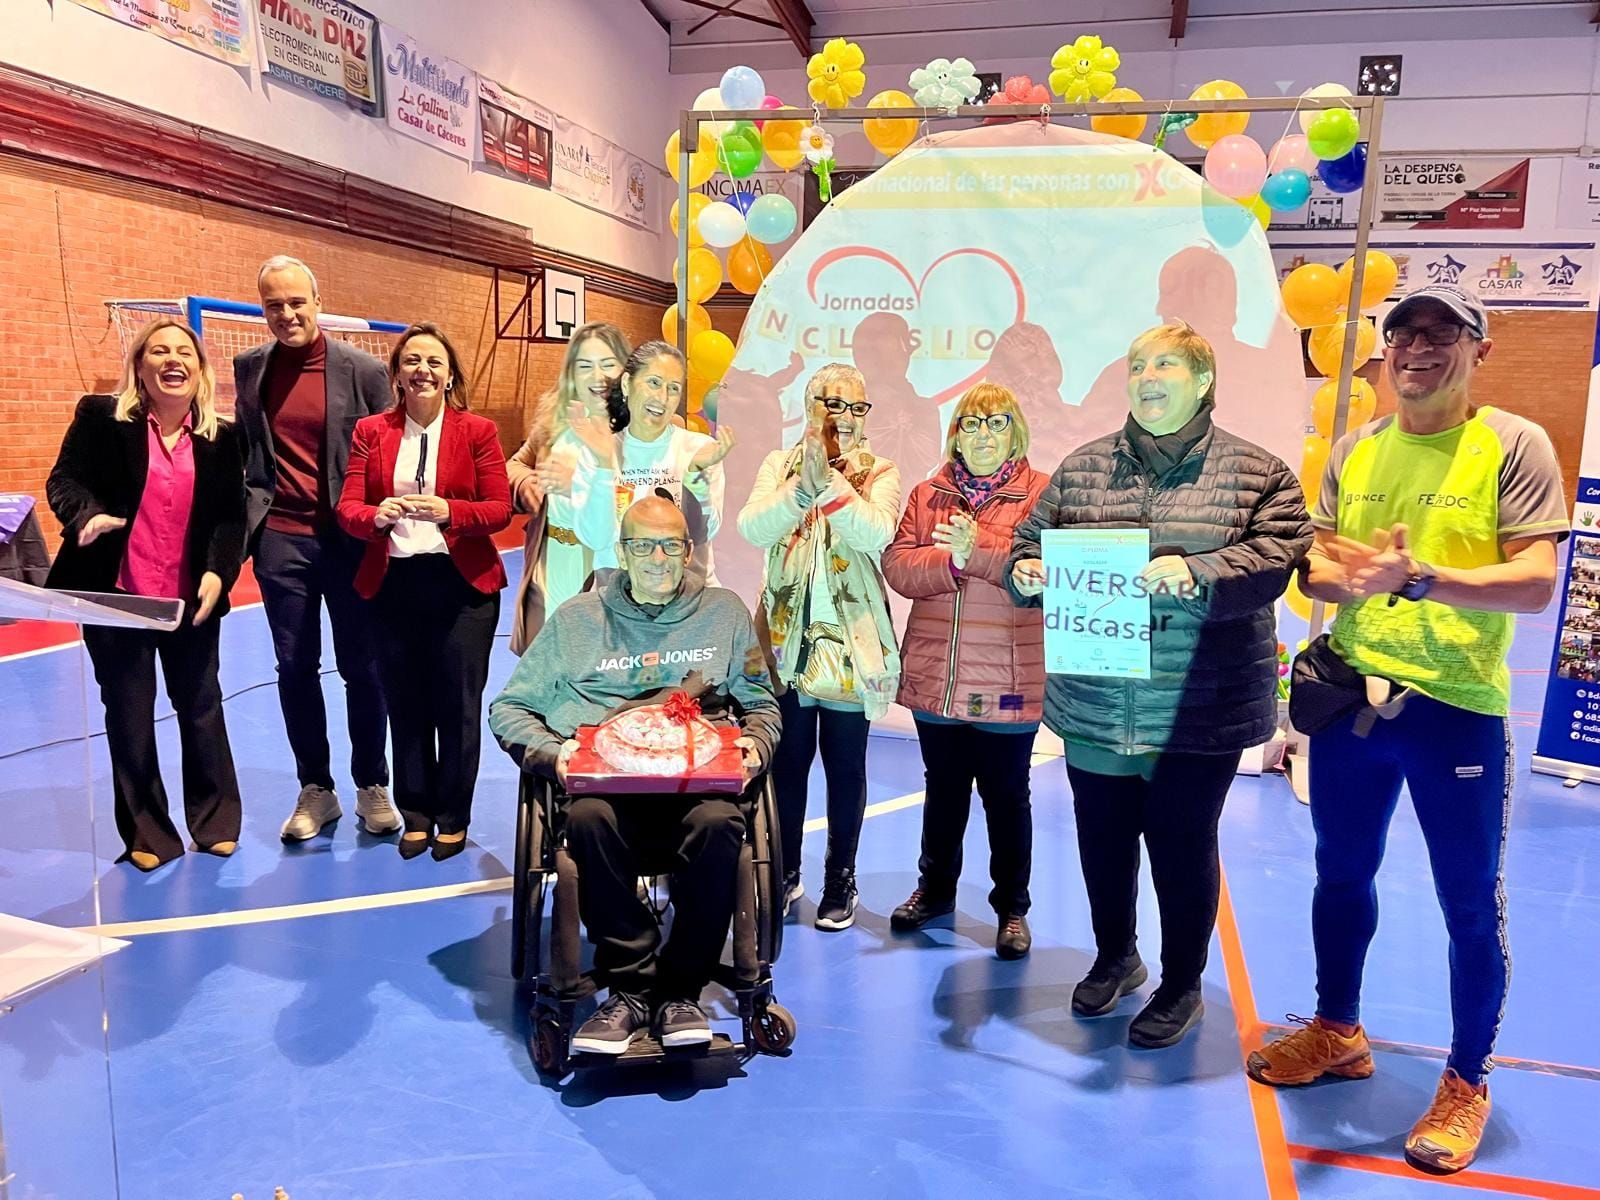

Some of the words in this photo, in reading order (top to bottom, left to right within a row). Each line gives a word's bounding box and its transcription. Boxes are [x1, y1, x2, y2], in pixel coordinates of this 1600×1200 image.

[303, 0, 365, 30] ecánico
[273, 45, 285, 58] EN
[286, 51, 328, 76] GENERAL
[268, 65, 293, 83] ASAR
[293, 73, 305, 87] DE
[306, 79, 346, 100] CÁCERE
[417, 93, 449, 121] Gallina
[398, 107, 424, 129] Casar
[425, 119, 436, 134] de
[1384, 163, 1401, 174] LA
[1404, 162, 1465, 174] DESPENSA
[1384, 174, 1412, 185] DEL
[1416, 173, 1467, 185] QUESO
[1009, 172, 1089, 198] personas
[1096, 174, 1129, 192] con
[1478, 279, 1523, 289] CASAR
[820, 293, 915, 312] Jornadas
[1354, 493, 1386, 503] ONCE
[1044, 605, 1174, 641] discasar
[595, 655, 642, 672] JACK
[659, 648, 714, 665] JONES
